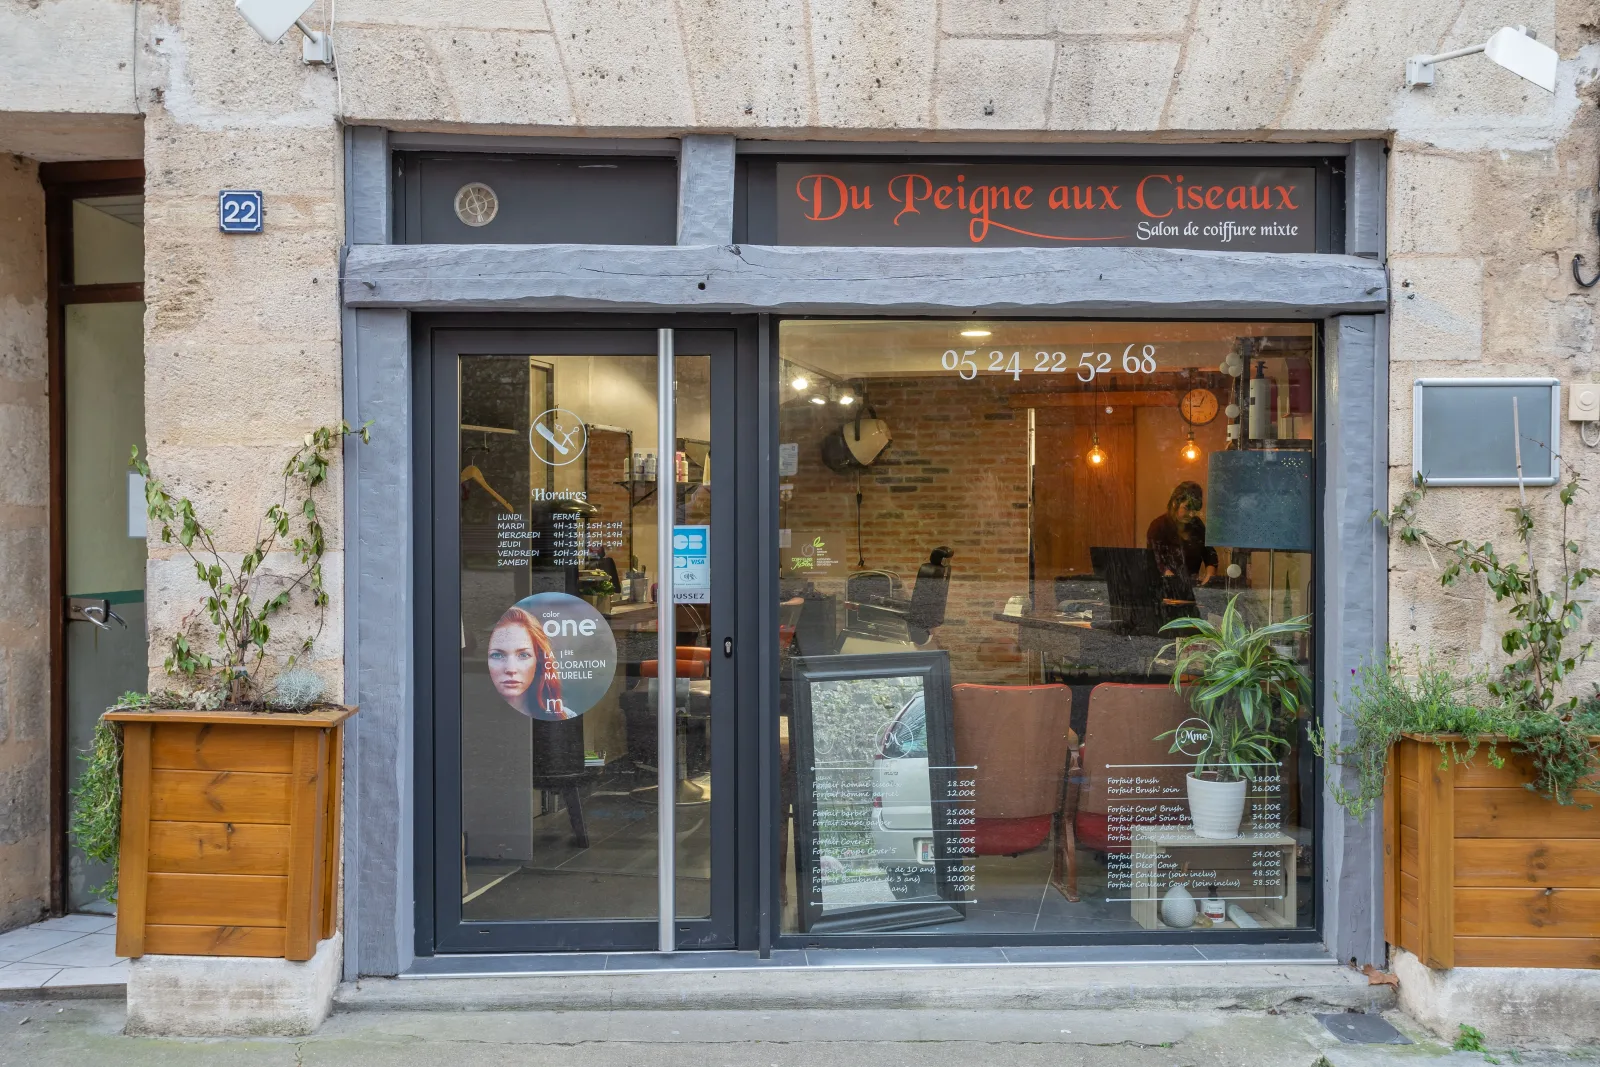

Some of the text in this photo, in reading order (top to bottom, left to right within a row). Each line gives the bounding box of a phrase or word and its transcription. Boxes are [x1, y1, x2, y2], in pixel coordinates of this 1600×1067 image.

[224, 200, 257, 223] 22
[797, 174, 1299, 242] Du Peigne aux Ciseaux
[1136, 221, 1299, 242] Salon de coiffure mixte
[941, 343, 1157, 382] 05 24 22 52 68
[531, 487, 587, 501] Horaires
[497, 511, 580, 521] LUNDI FERMÉ
[497, 522, 525, 530] MARDI
[497, 531, 541, 539] MERCREDI
[497, 540, 521, 548] JEUDI
[497, 549, 540, 557] VENDREDI
[497, 558, 529, 566] SAMEDI
[673, 592, 705, 600] USSEZ
[542, 618, 597, 637] one
[544, 650, 555, 659] LA
[544, 659, 606, 670] COLORATION
[544, 670, 593, 680] NATURELLE
[1180, 729, 1208, 744] Mme
[947, 779, 976, 787] 18.50€
[1107, 777, 1134, 786] Forfait
[1135, 776, 1160, 785] Brush
[946, 789, 976, 797] 12.00€
[1107, 786, 1134, 795] Forfait
[1162, 785, 1180, 793] soin
[1251, 784, 1281, 792] 26.00€
[946, 808, 976, 816] 25.00€
[1107, 805, 1134, 814] Forfait
[1160, 804, 1185, 812] Brush
[1252, 803, 1281, 811] 31.00€
[946, 817, 976, 825] 28.00€
[1107, 815, 1134, 824] Forfait
[1159, 814, 1177, 822] Soin
[1252, 812, 1281, 820] 34.00€
[1107, 824, 1134, 833] Forfait
[1251, 822, 1281, 830] 26.00€
[946, 836, 976, 844] 25.00€
[1107, 834, 1134, 843] Forfait
[946, 846, 976, 854] 35.00€
[1107, 852, 1134, 861] Forfait
[1252, 850, 1281, 858] 54.00€
[907, 865, 918, 873] 10
[946, 865, 976, 873] 16.00€
[1107, 862, 1134, 871] Forfait
[946, 874, 976, 882] 10.00€
[1107, 871, 1134, 880] Forfait
[1135, 871, 1167, 879] Couleur
[1252, 869, 1281, 877] 48.50€
[1107, 881, 1134, 890] Forfait
[1135, 880, 1167, 889] Couleur
[1252, 878, 1281, 886] 58.50€
